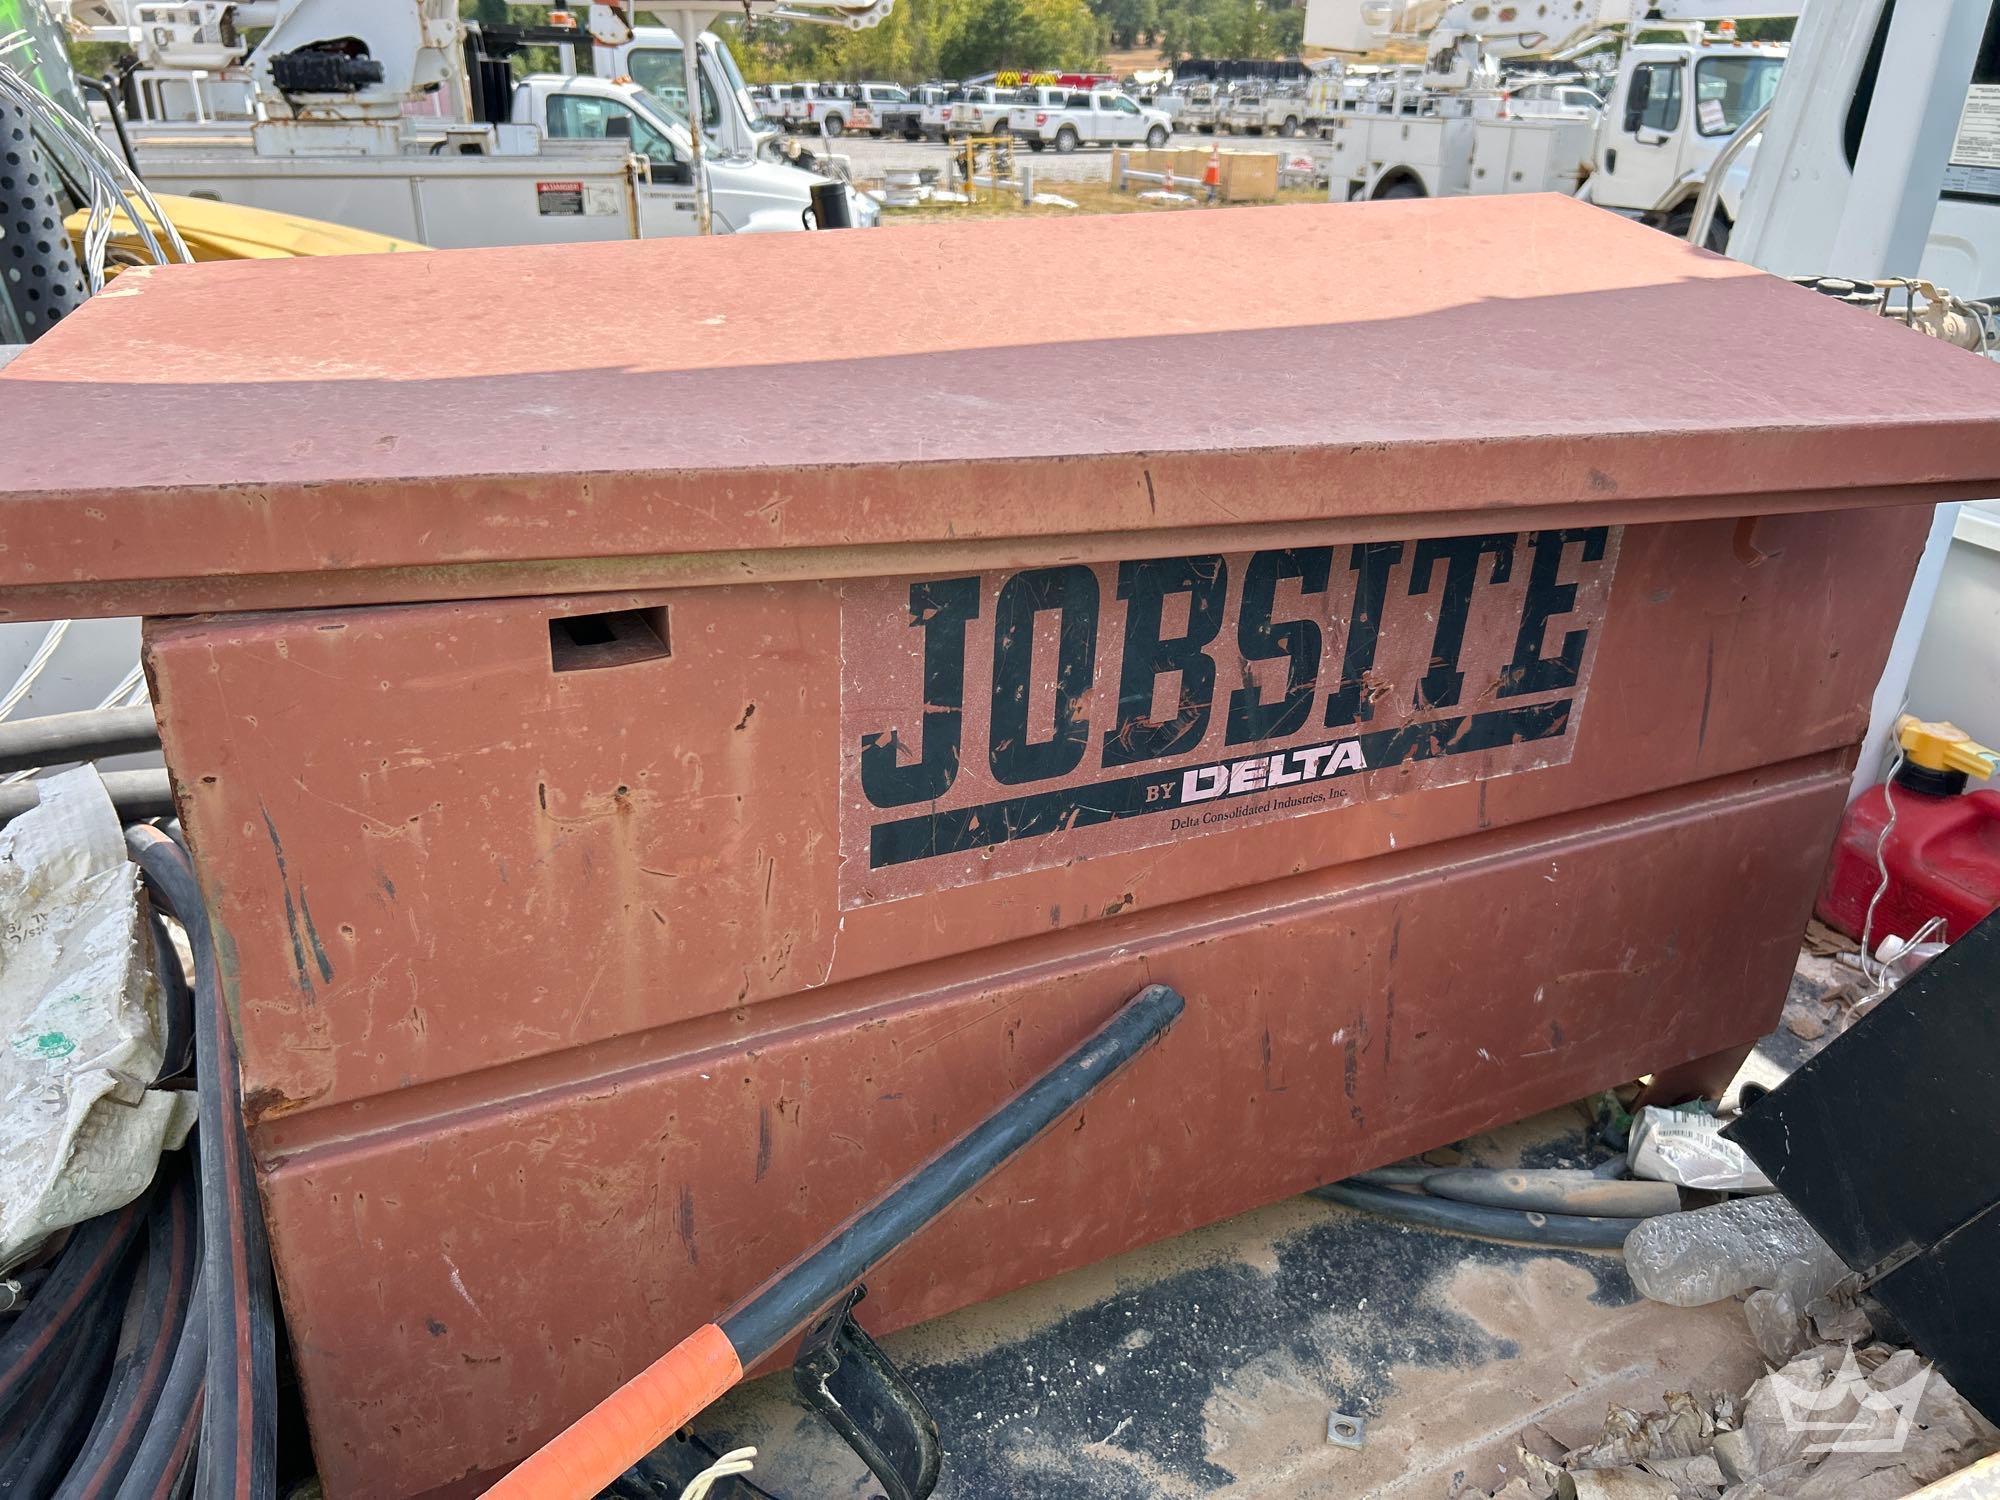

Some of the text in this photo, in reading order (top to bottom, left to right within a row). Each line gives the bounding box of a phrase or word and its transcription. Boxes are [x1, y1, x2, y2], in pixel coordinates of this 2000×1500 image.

[861, 526, 1609, 807] JOBSITE
[1145, 740, 1368, 803] BY DELTA
[1170, 787, 1348, 831] Delta Consolidated Industries, Inc.
